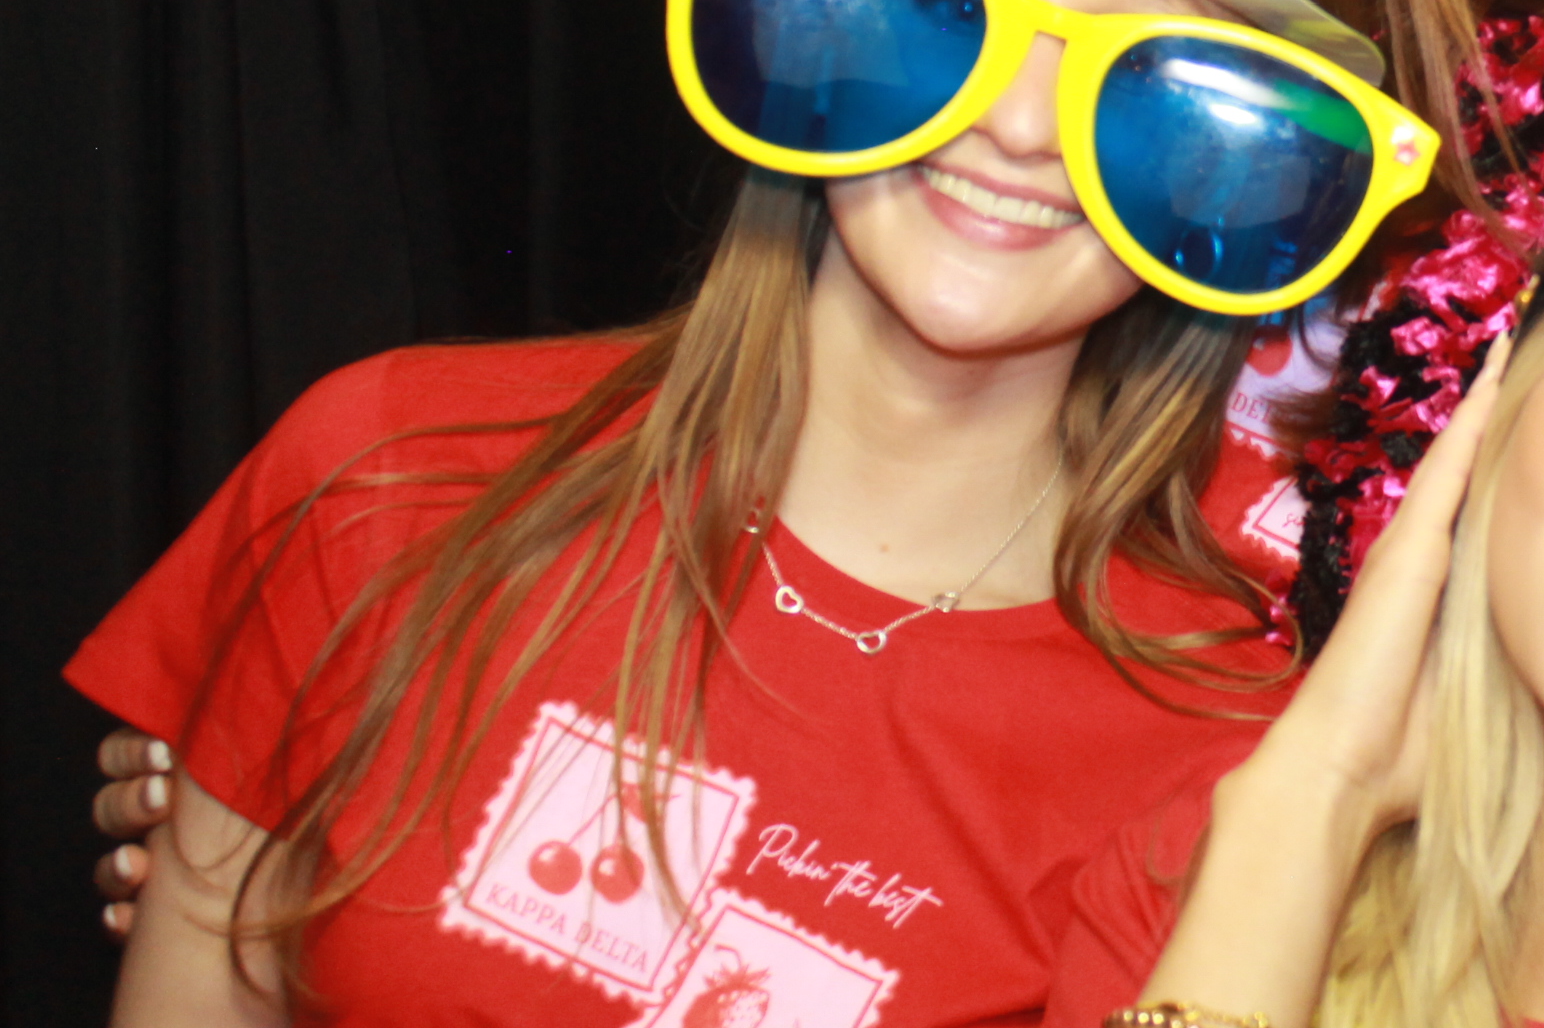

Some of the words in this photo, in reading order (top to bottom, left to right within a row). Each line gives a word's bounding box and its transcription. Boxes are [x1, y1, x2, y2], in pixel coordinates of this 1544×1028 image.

[486, 883, 567, 935] KAPPA
[574, 922, 649, 972] DELTA
[868, 873, 944, 929] best
